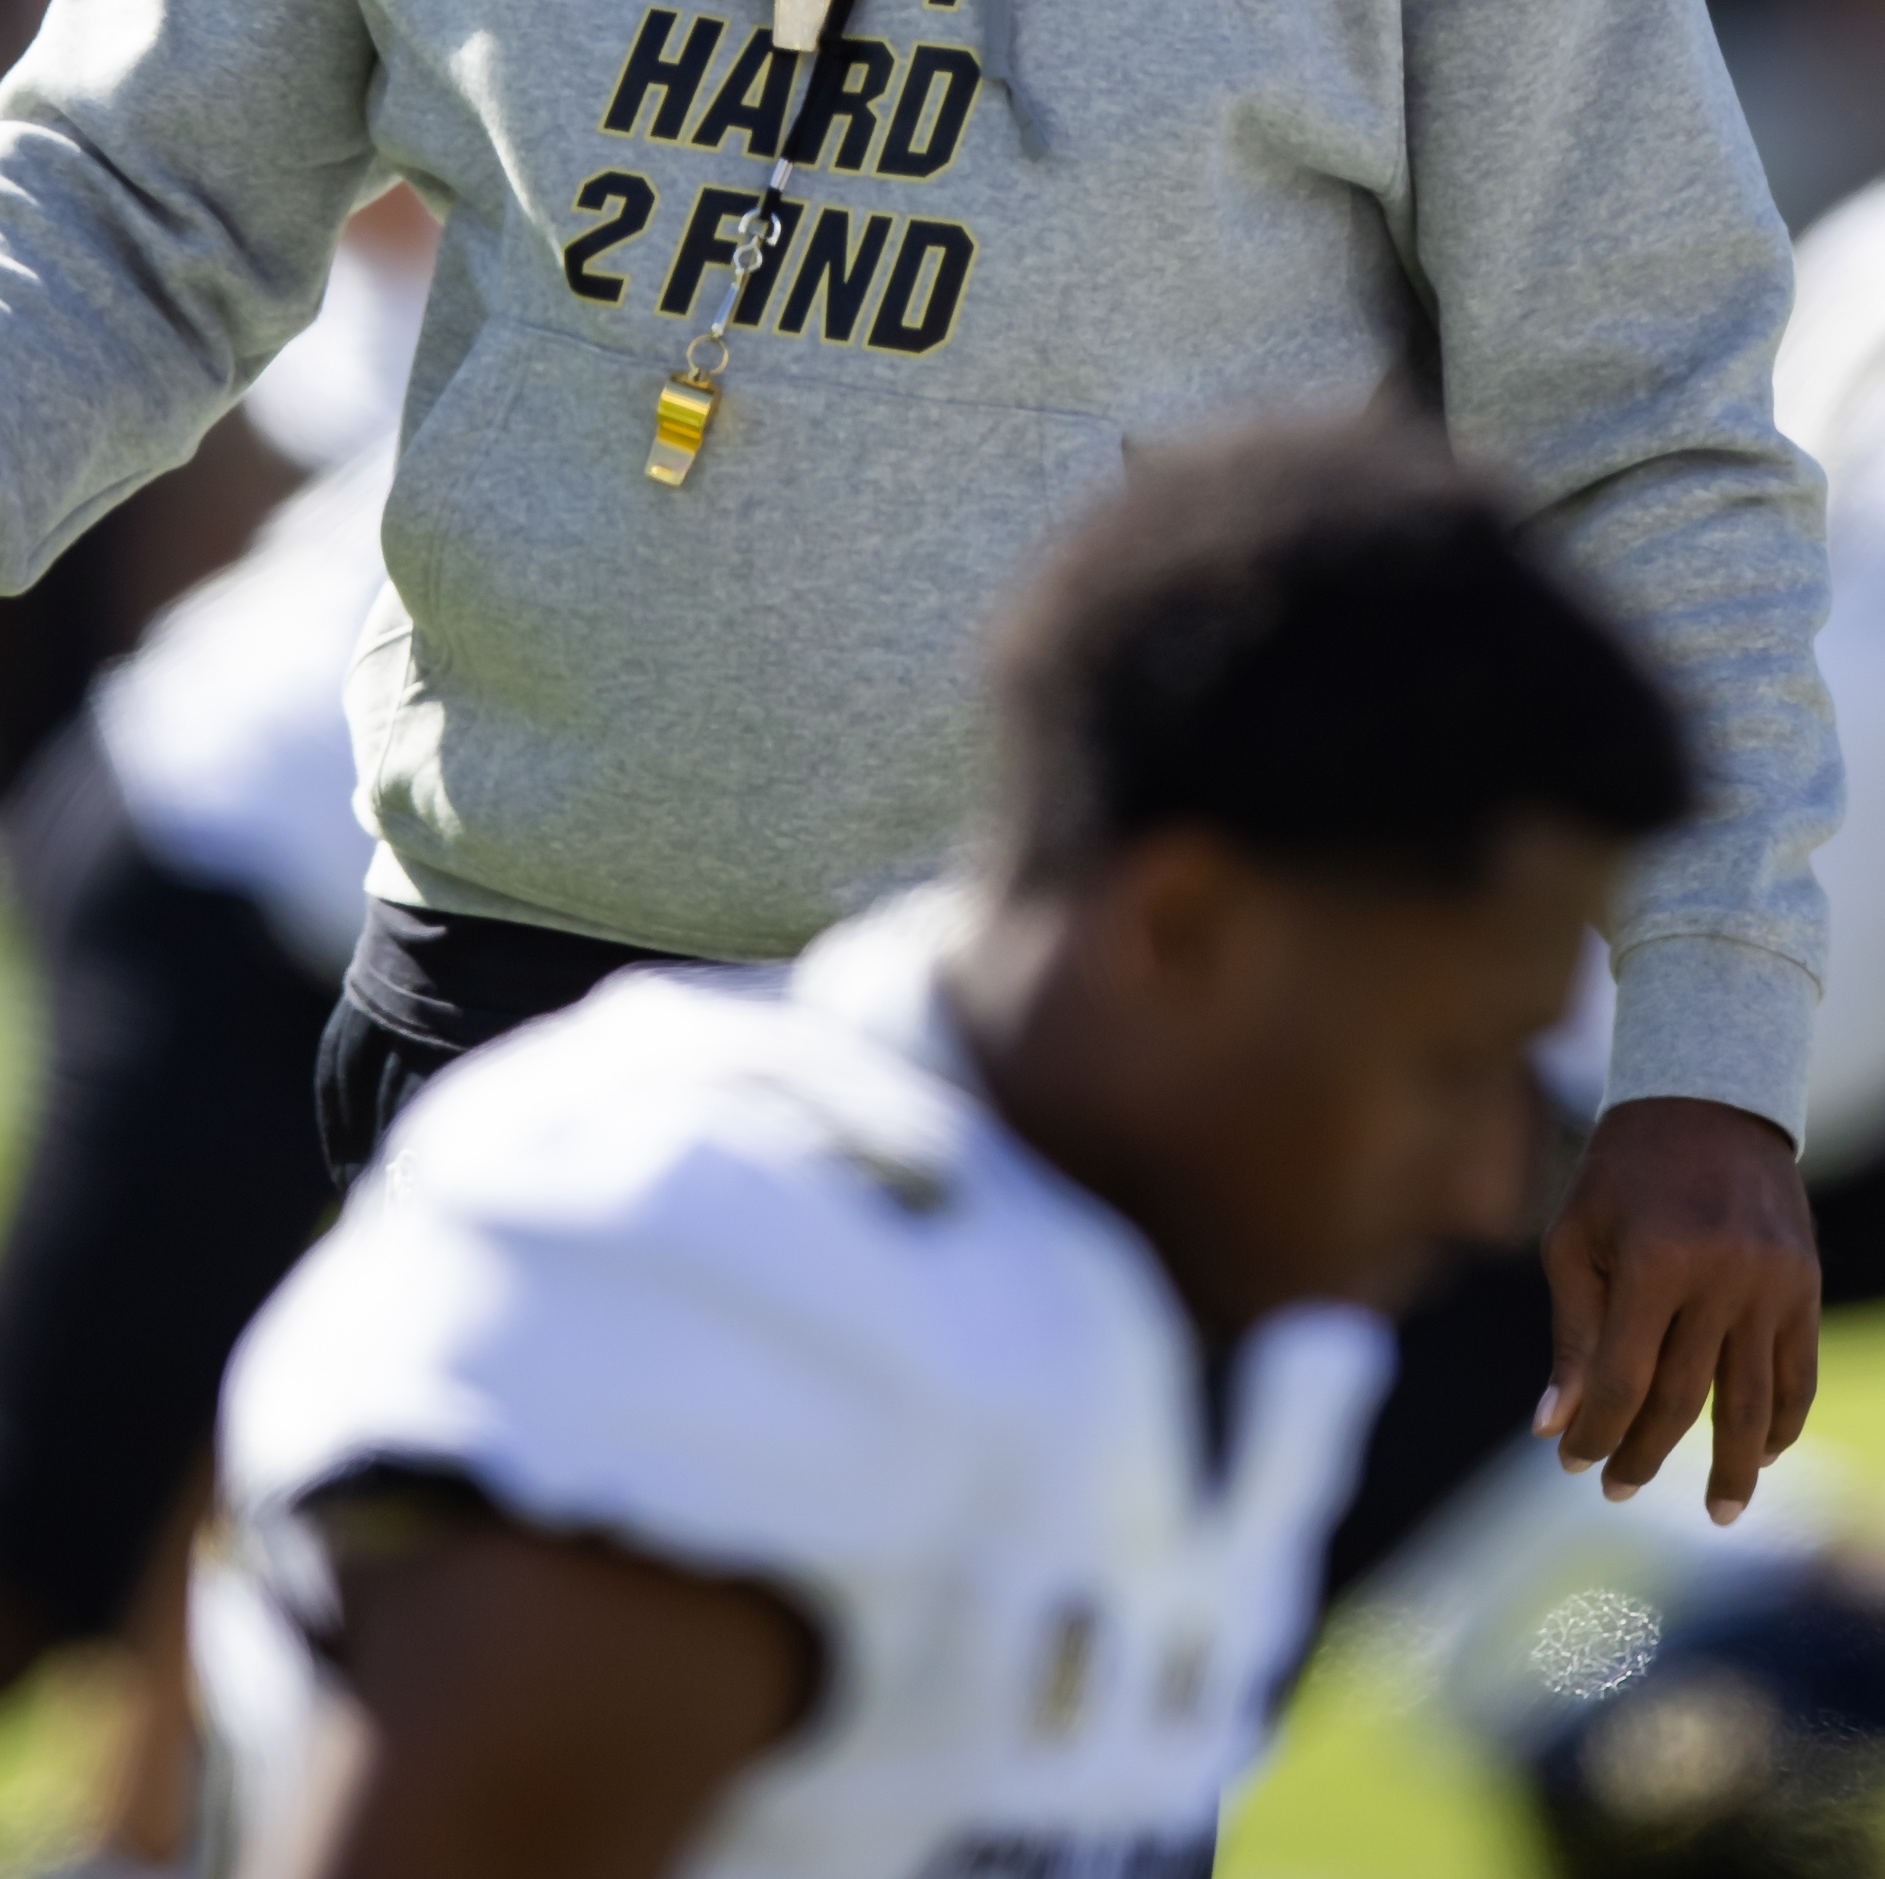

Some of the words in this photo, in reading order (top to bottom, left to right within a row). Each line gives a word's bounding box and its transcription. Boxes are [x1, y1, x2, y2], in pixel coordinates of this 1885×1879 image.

[598, 7, 983, 182] HARD
[562, 169, 660, 308] 2
[654, 183, 981, 357] FIND
